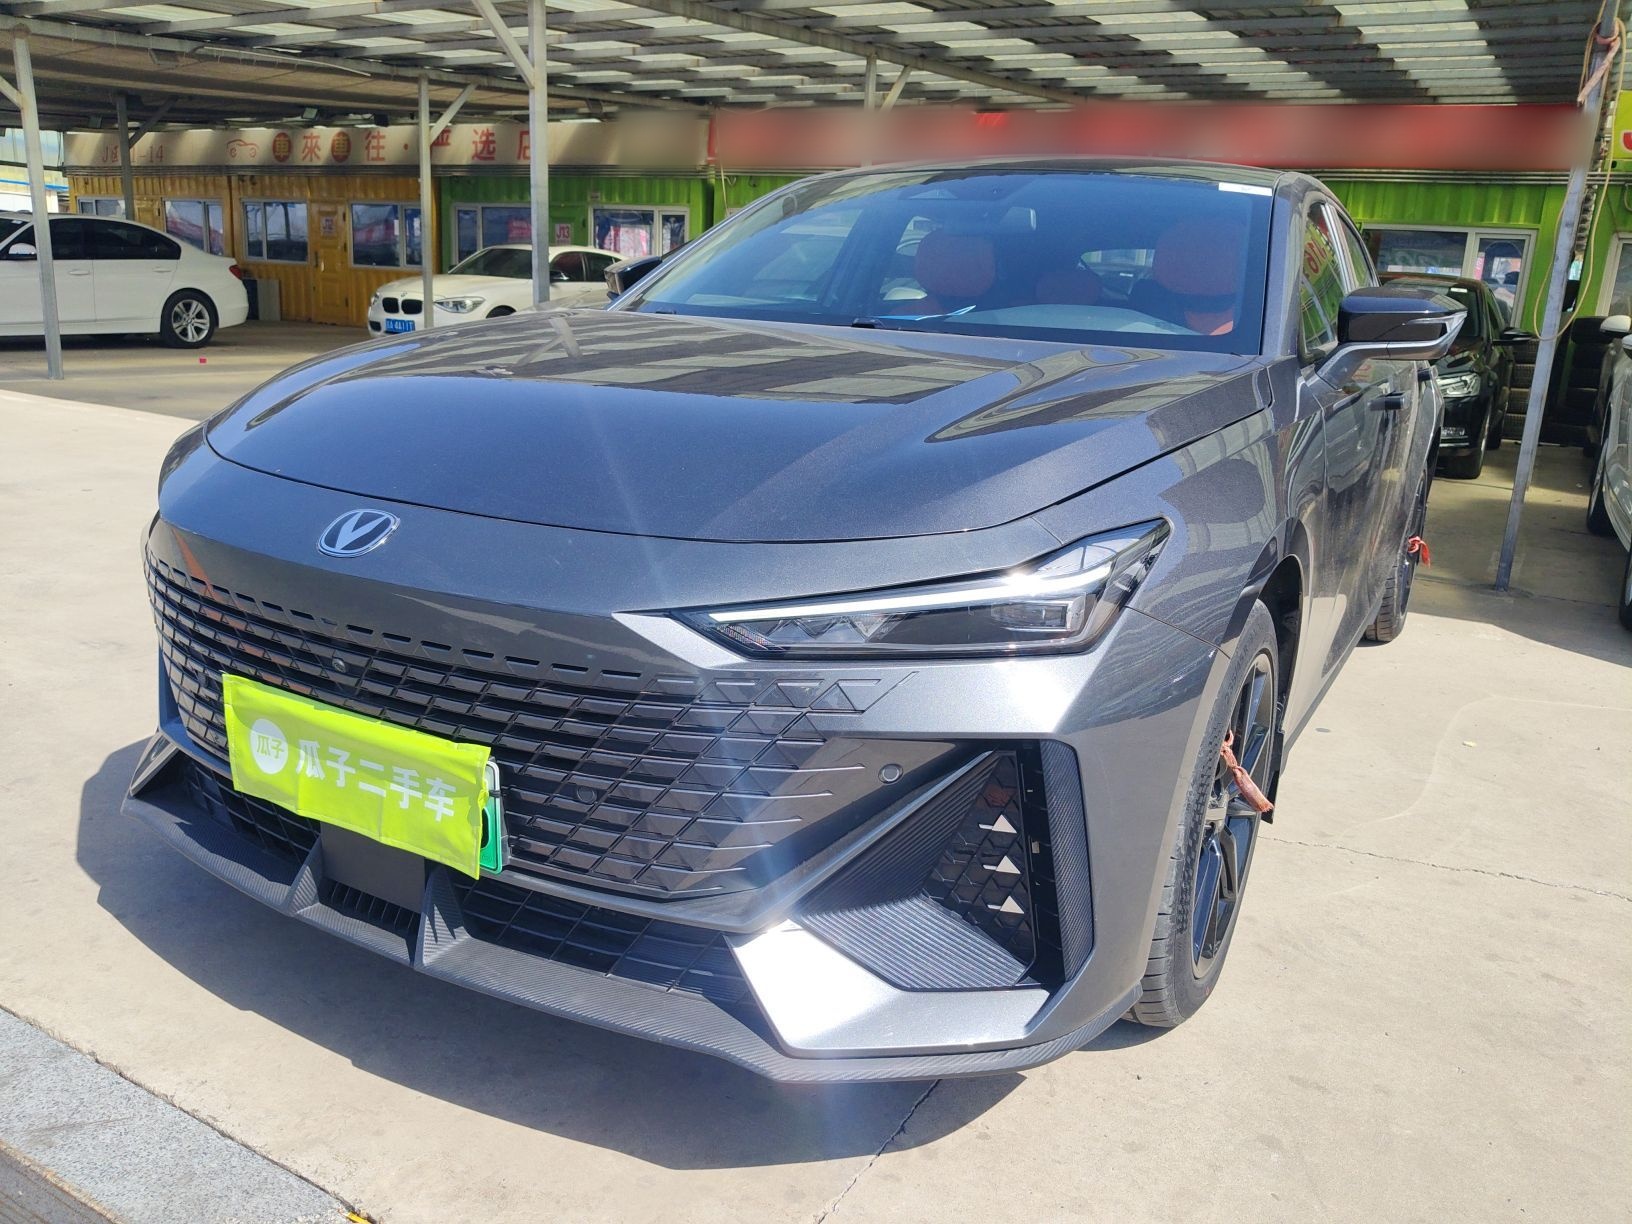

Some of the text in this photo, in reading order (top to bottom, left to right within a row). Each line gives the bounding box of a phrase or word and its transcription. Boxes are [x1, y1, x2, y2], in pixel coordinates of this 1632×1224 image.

[256, 735, 285, 760] 瓜子
[295, 738, 457, 823] 瓜子二手车
